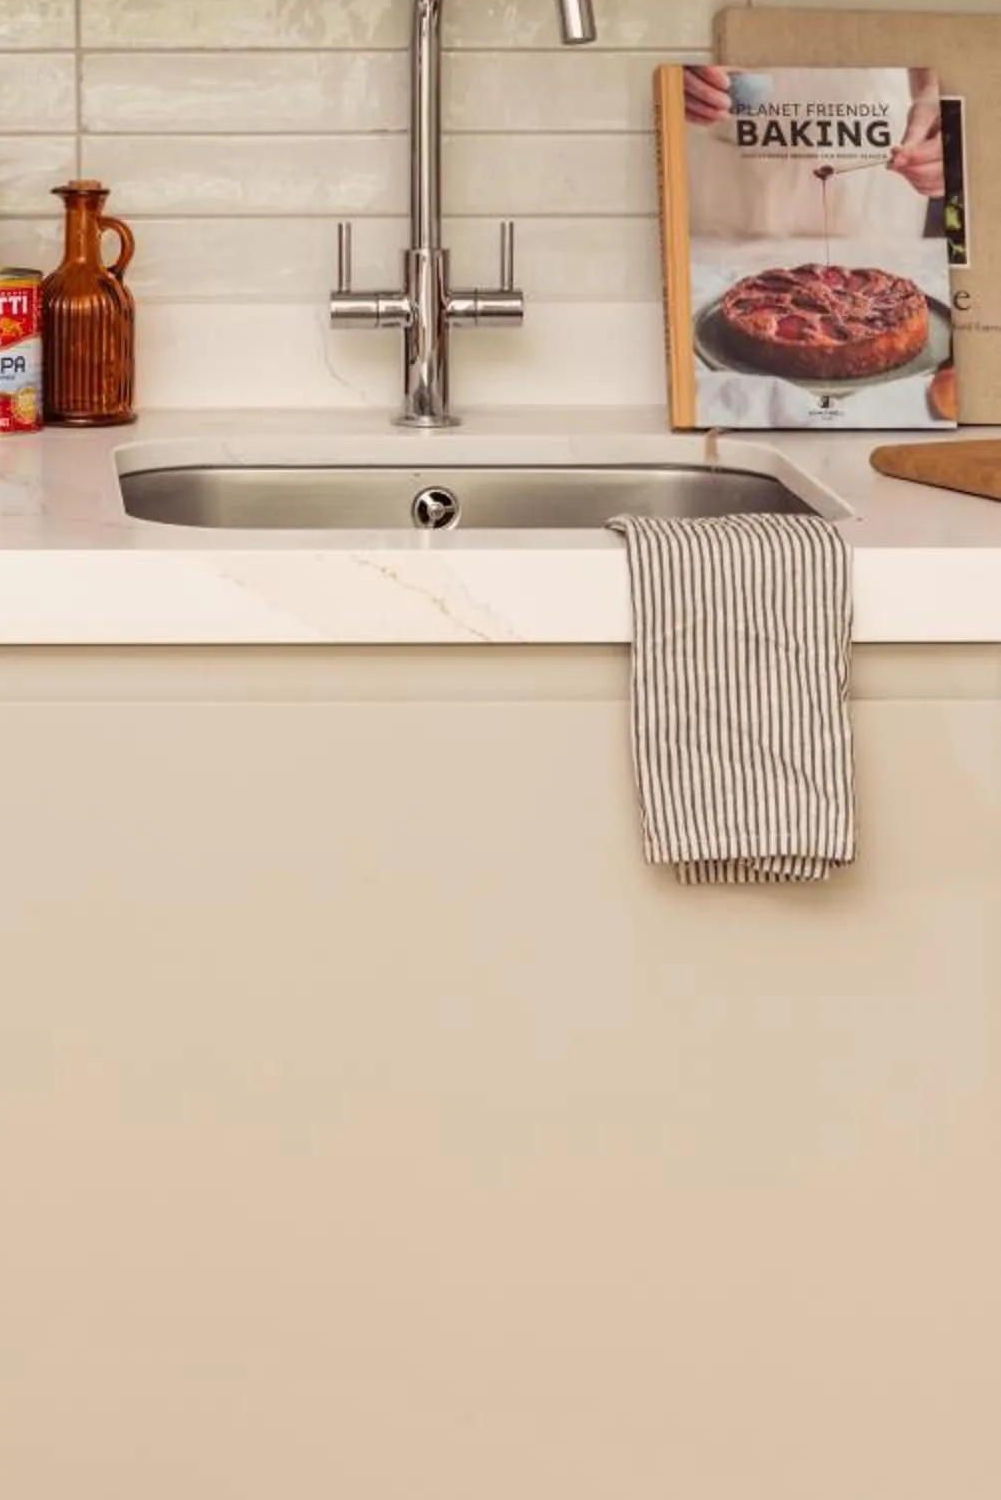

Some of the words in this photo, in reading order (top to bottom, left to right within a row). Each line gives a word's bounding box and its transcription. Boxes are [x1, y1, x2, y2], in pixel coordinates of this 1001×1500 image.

[737, 103, 800, 117] PLANET
[807, 103, 889, 117] FRIENDLY
[736, 119, 891, 147] BAKING
